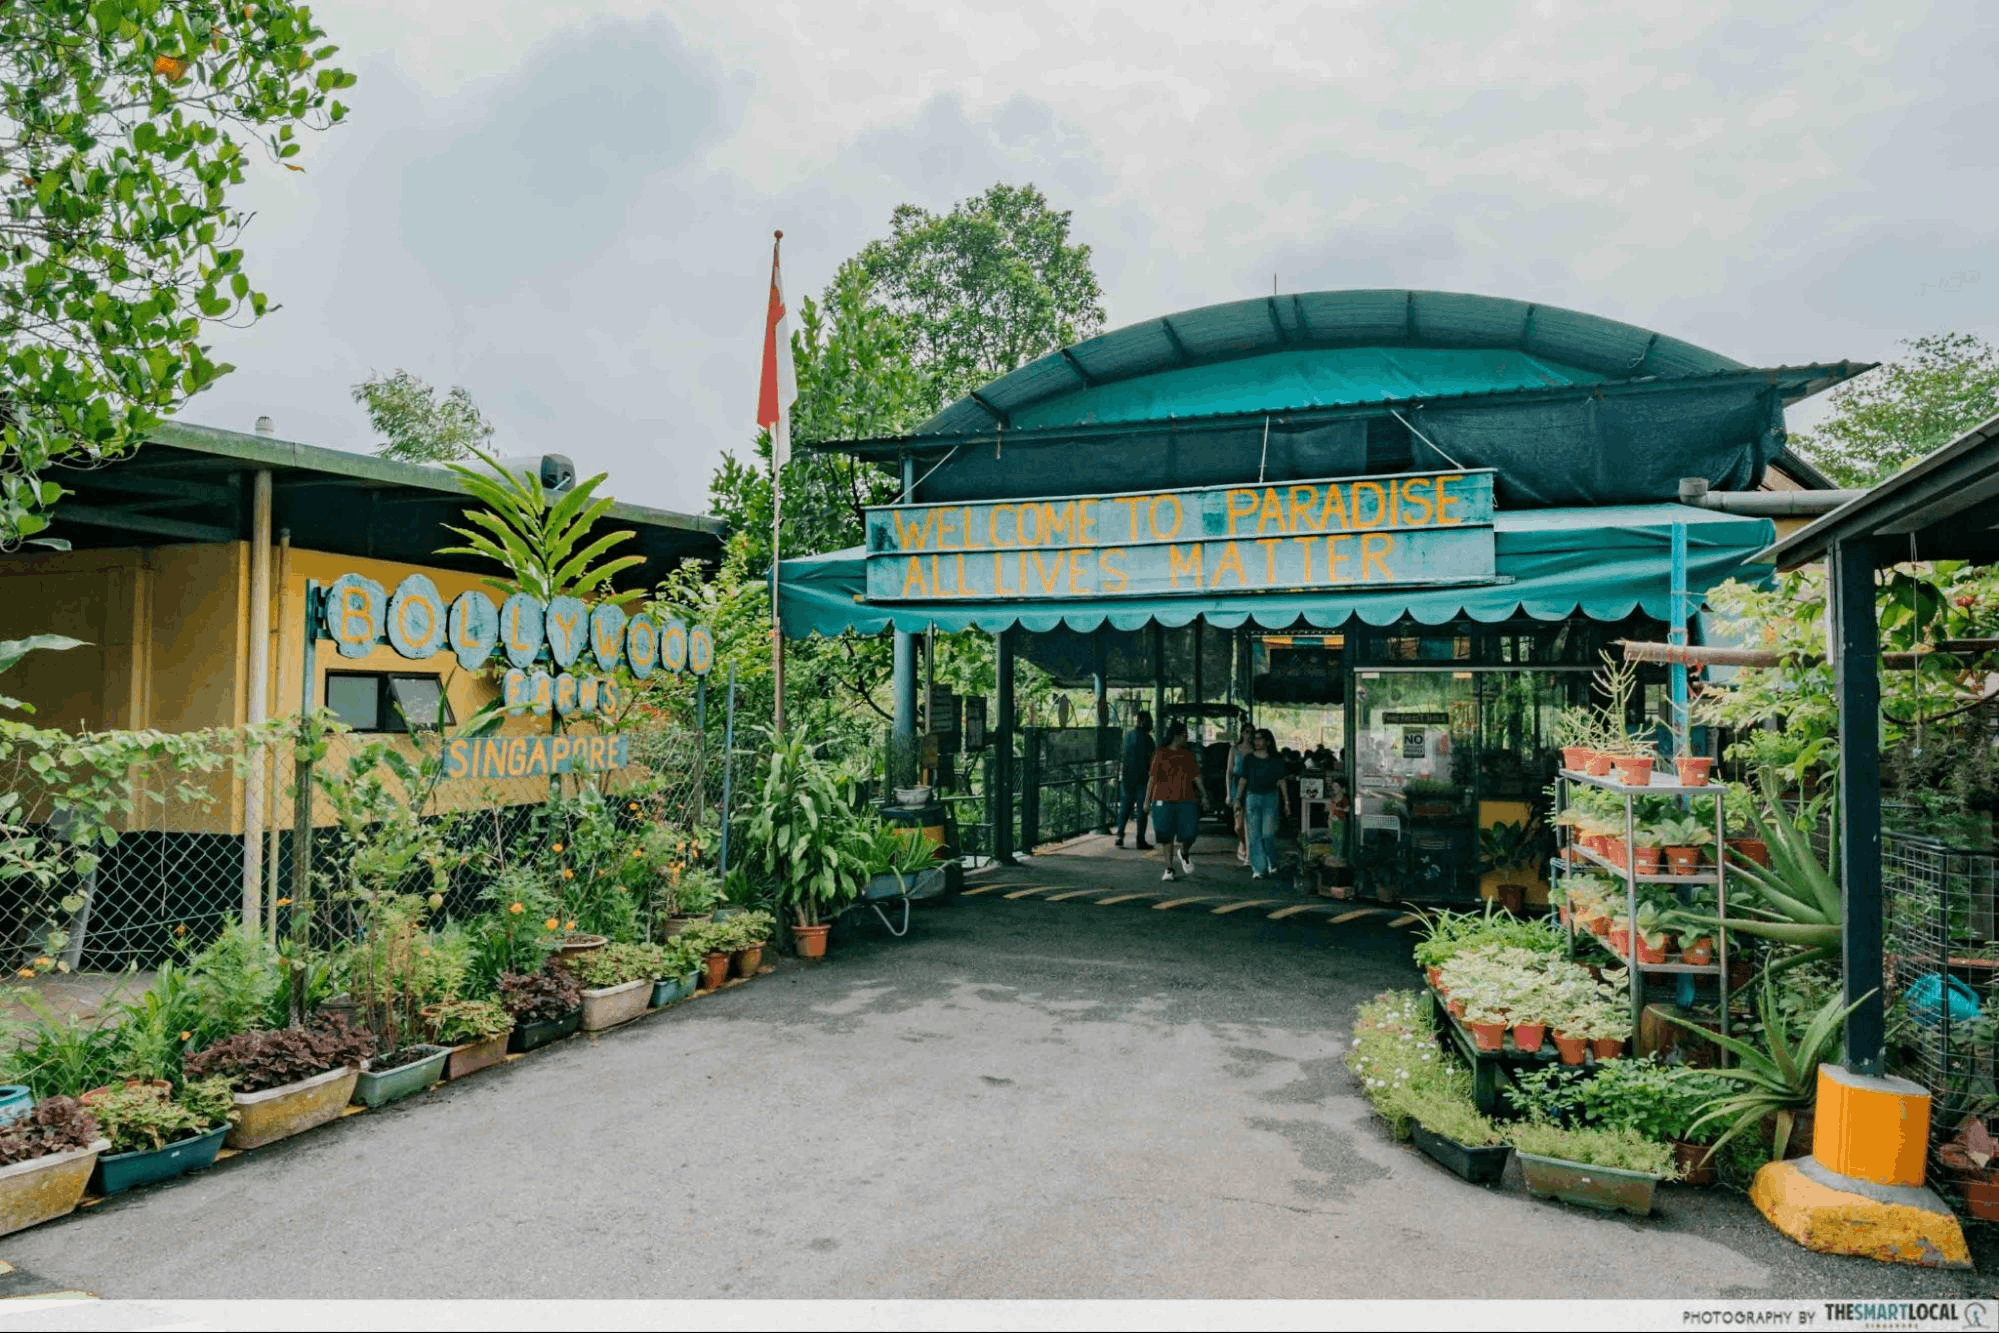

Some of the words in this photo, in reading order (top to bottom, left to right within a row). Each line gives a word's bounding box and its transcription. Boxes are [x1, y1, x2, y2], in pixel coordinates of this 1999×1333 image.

[893, 498, 1099, 551] WELCOME
[1113, 494, 1183, 542] TO
[1226, 475, 1464, 535] PARADISE
[901, 554, 980, 599] ALL
[993, 547, 1129, 597] LIVES
[1169, 532, 1395, 590] MATTER
[340, 585, 713, 673] BOLLYWOOD
[507, 673, 618, 716] FARMS
[1404, 734, 1424, 745] NO
